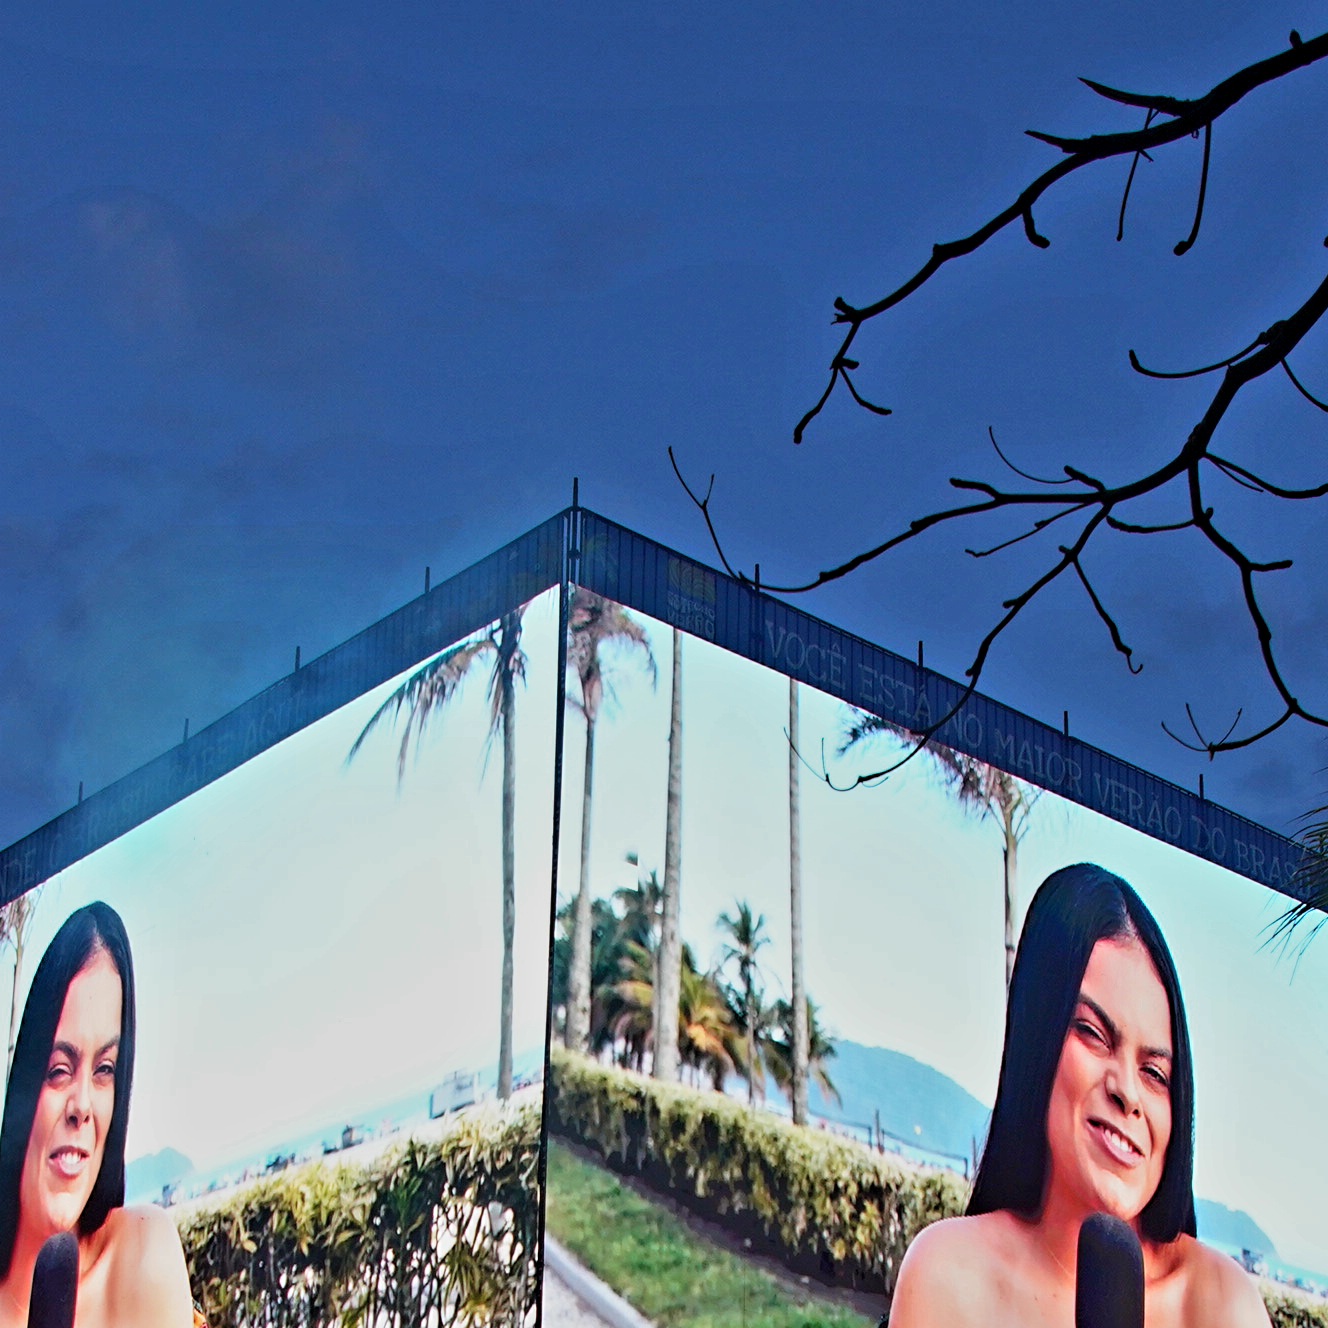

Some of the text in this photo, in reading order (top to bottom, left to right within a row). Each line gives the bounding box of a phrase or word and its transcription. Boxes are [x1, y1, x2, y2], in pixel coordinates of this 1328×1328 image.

[765, 617, 848, 690] VOCÊ
[856, 662, 931, 723] ESTÁ
[940, 700, 983, 749] NO
[994, 727, 1083, 798] MAIOR
[1093, 773, 1183, 840] VERÃO
[1191, 815, 1226, 860] DO
